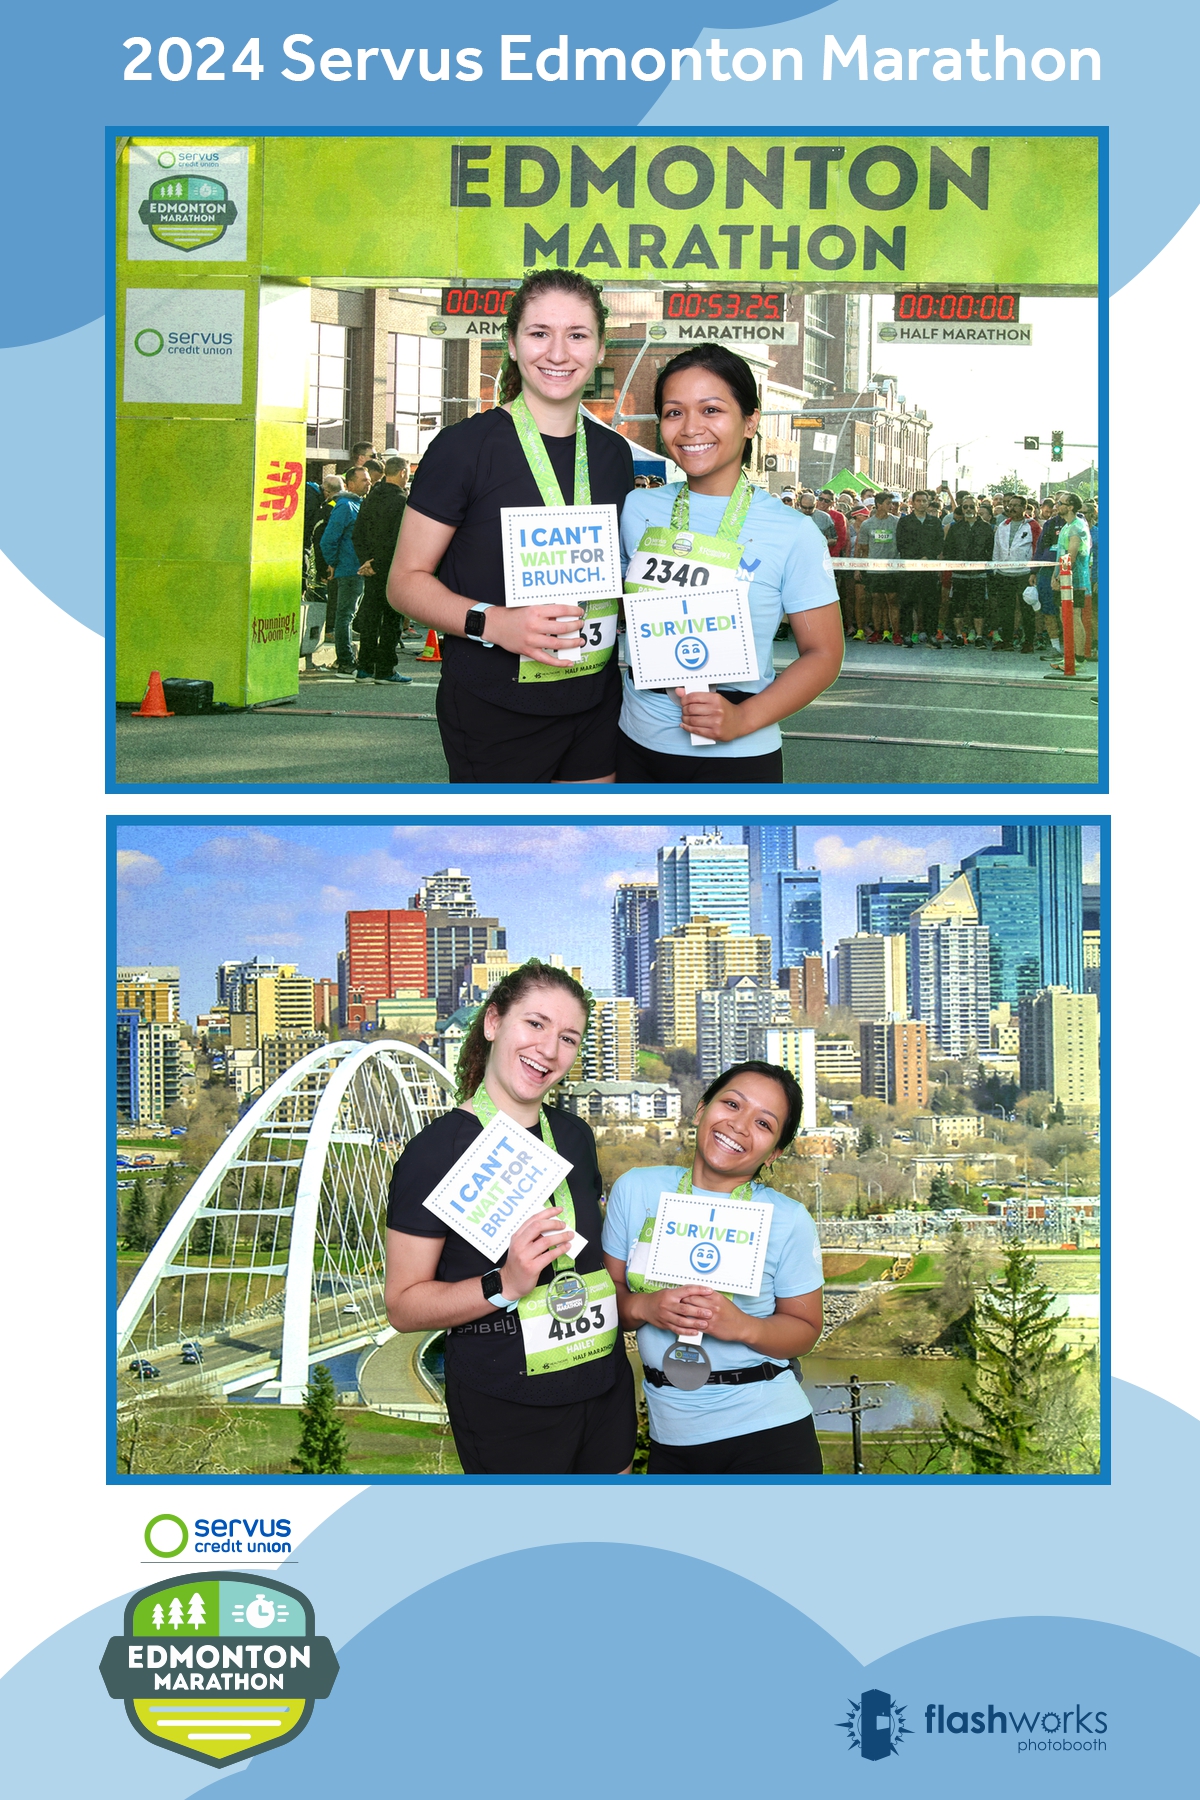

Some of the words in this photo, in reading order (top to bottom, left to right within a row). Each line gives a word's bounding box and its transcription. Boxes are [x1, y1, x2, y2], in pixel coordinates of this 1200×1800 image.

[178, 153, 219, 161] servus
[450, 145, 990, 210] EDMONTON
[149, 203, 226, 213] EDMONTON
[160, 214, 215, 222] MARATHON
[523, 223, 906, 270] MARATHON
[168, 332, 232, 344] servus
[679, 325, 785, 340] MARATHON
[900, 328, 938, 339] HALF
[943, 328, 1031, 341] MARATHON
[168, 346, 199, 354] credit
[520, 529, 527, 547] I
[531, 526, 602, 545] CAN'T
[520, 550, 567, 567] WAIT
[571, 549, 605, 564] FOR
[522, 567, 606, 587] BRUNCH.
[642, 557, 710, 587] 2340
[682, 600, 688, 614] I
[640, 615, 737, 638] SURVIVED!
[564, 667, 578, 675] HALF
[450, 1200, 465, 1213] I
[460, 1136, 515, 1202] CAN'T
[466, 1181, 505, 1225] WAIT
[500, 1151, 533, 1185] FOR
[481, 1166, 547, 1238] BRUNCH.
[710, 1209, 716, 1222] I
[665, 1221, 755, 1246] SURVIVED!
[566, 1338, 596, 1354] HAILEY
[572, 1353, 587, 1361] HALF
